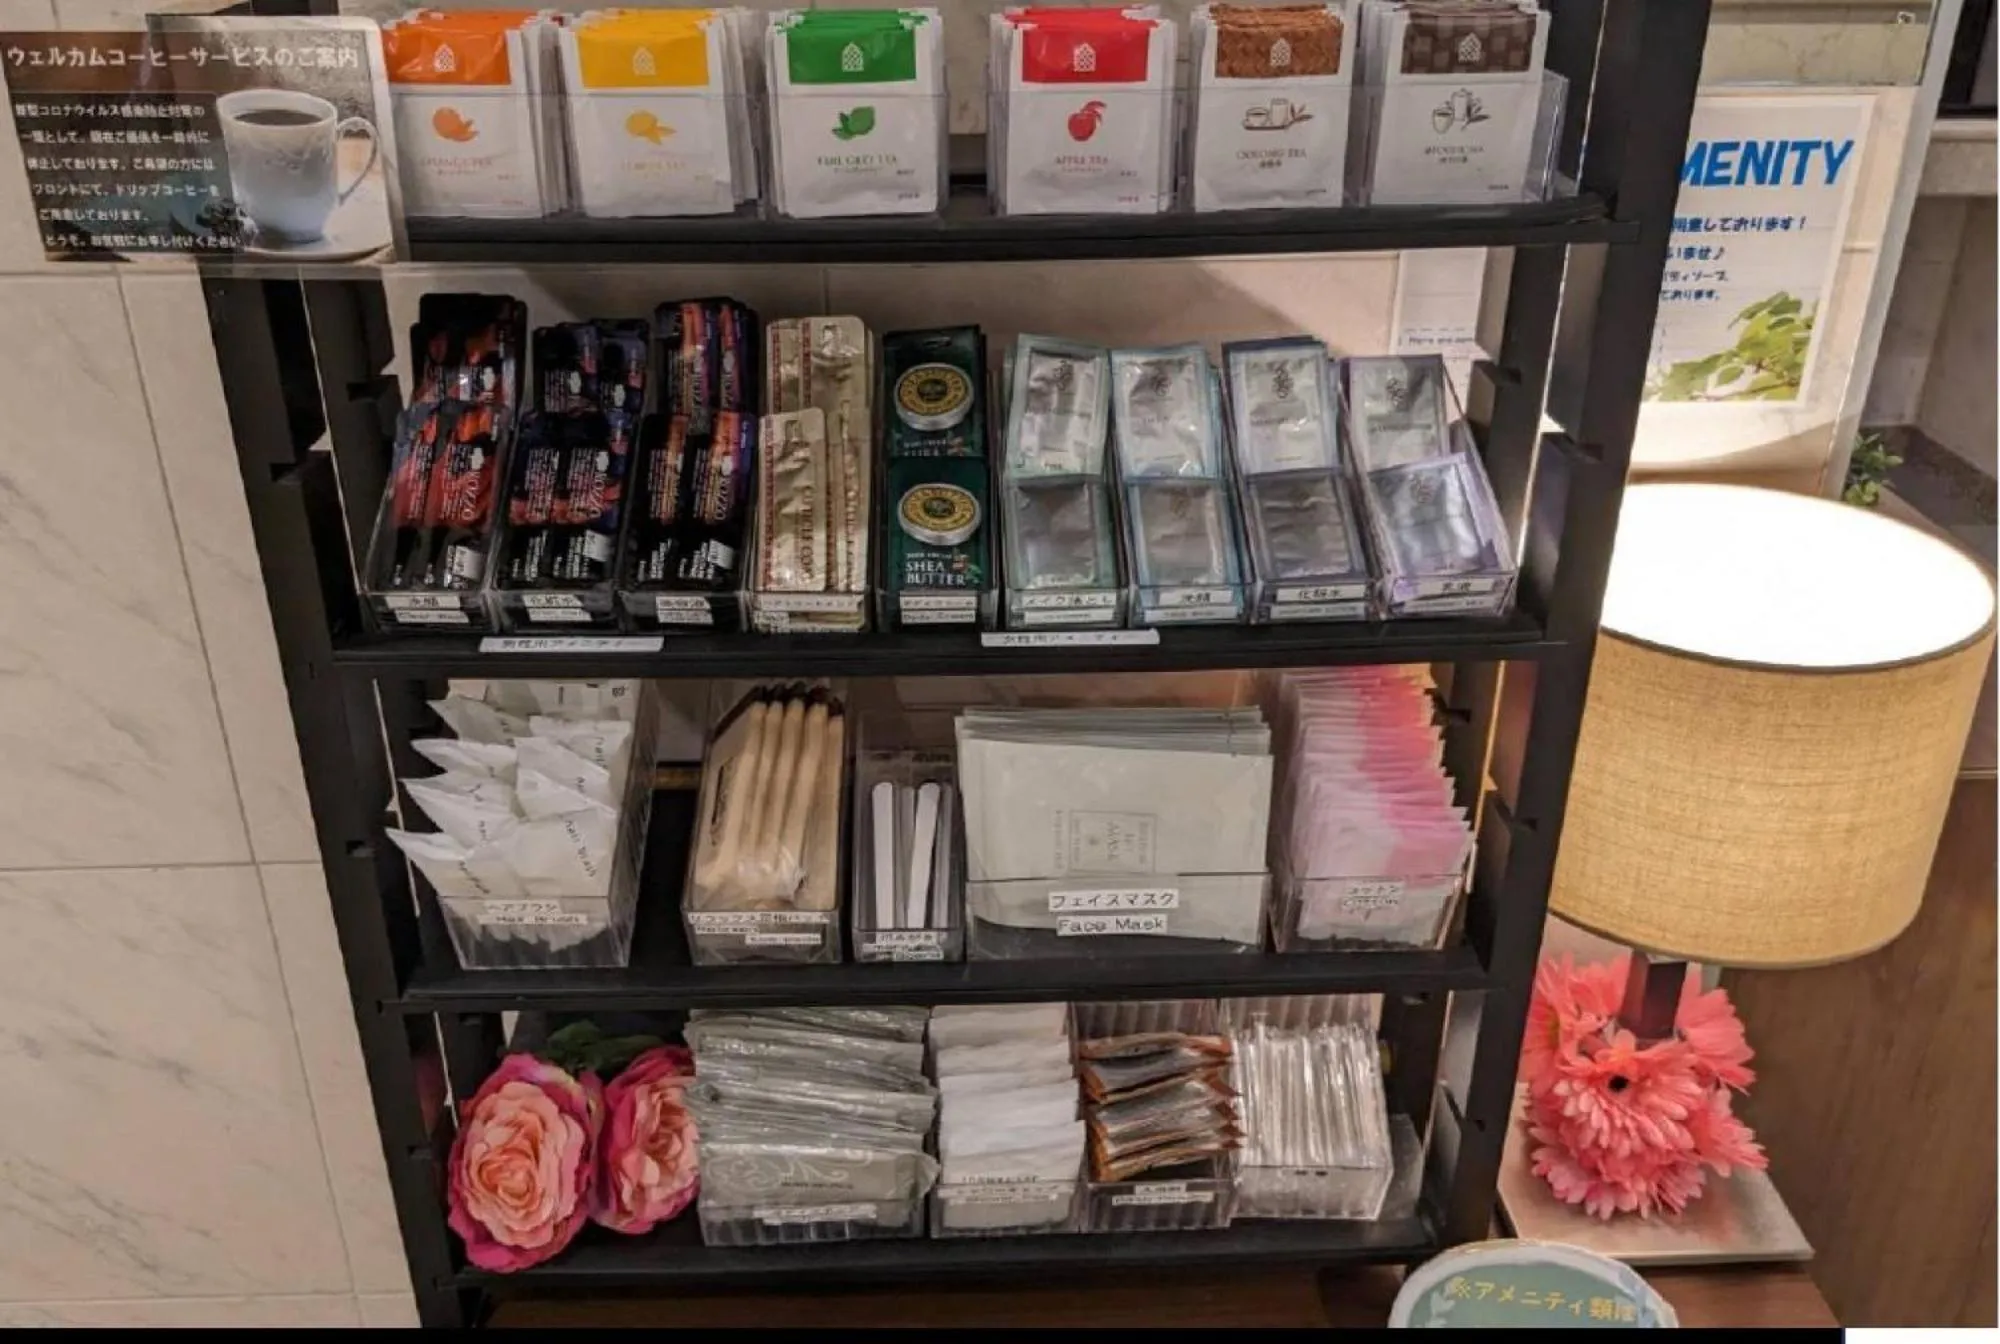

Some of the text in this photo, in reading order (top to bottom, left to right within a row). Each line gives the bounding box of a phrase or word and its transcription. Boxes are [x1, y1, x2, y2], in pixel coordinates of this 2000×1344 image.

[7, 46, 358, 69] ウェルカムコーヒーサービスのご案内
[905, 560, 945, 572] SHEA
[906, 573, 967, 586] BUTTER
[1051, 892, 1175, 909] フェイスマスク
[1058, 917, 1163, 933] Face Mask
